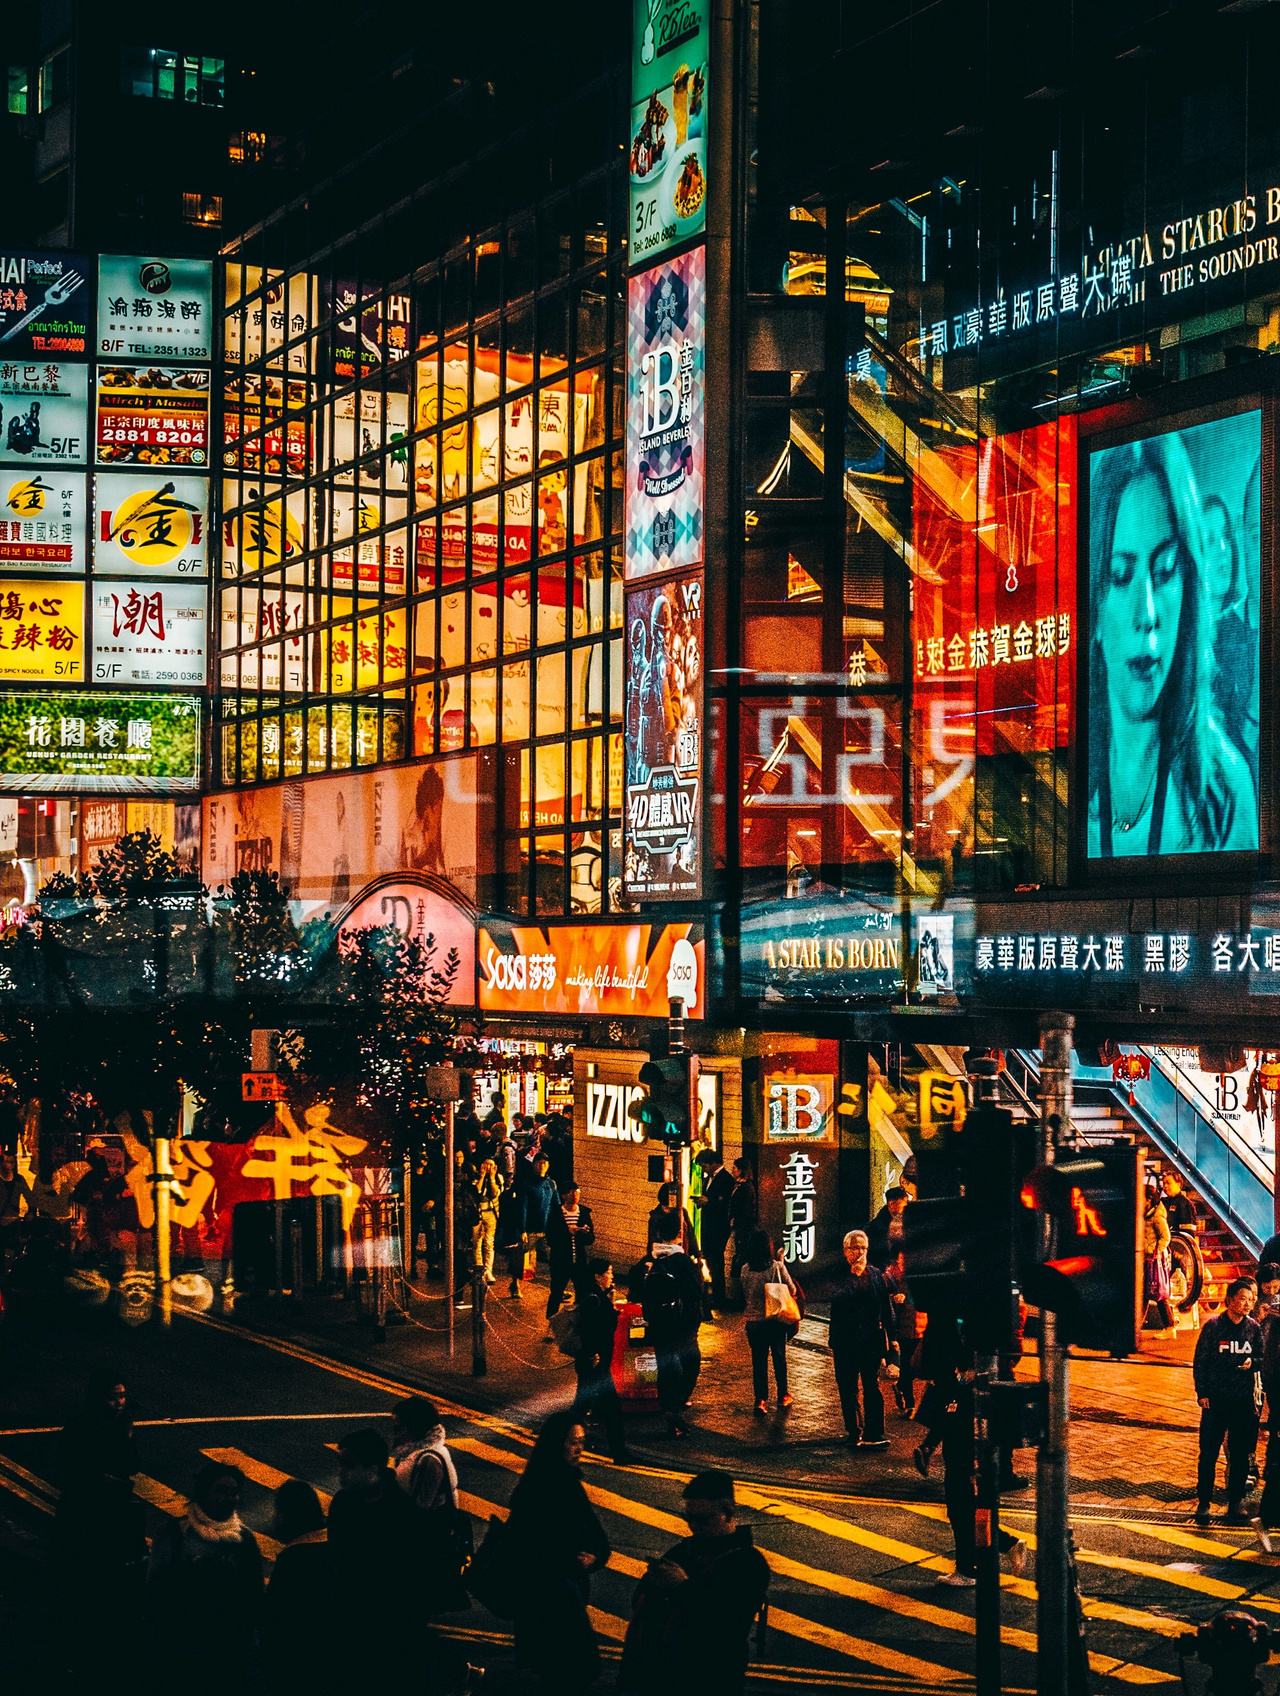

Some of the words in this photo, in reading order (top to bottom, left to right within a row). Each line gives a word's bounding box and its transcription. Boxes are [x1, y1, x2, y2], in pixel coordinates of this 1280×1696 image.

[635, 199, 656, 233] 3/F
[645, 231, 660, 250] 2660
[1161, 207, 1223, 260] STAR
[27, 259, 62, 275] Perfect
[1159, 264, 1194, 296] THE
[966, 254, 1132, 345] 豪華版原聲大碟
[101, 339, 125, 352] 8/F
[128, 344, 152, 354] TEL:
[154, 345, 179, 355] 2351
[182, 347, 208, 357] 1323
[0, 363, 61, 383] 新巴黎
[190, 373, 208, 385] 7/F
[680, 338, 693, 424] 金百利
[103, 396, 144, 406] Mirch
[155, 399, 204, 408] Masala
[103, 416, 206, 431] 正宗印度風味屋
[50, 438, 80, 453] 5/F
[102, 429, 149, 442] 2881
[155, 431, 205, 444] 8204
[638, 437, 661, 454] ISLAND
[662, 425, 693, 446] BEVERLEY
[645, 476, 660, 496] Well
[660, 467, 686, 494] Dressed
[61, 490, 73, 499] 6/F
[177, 559, 202, 573] 6/F
[681, 583, 701, 610] VR
[111, 587, 166, 641] 潮
[54, 661, 80, 675] 5/F
[96, 663, 122, 679] 5/F
[156, 670, 178, 680] 2590
[181, 671, 203, 681] 0368
[172, 705, 193, 717] 4/F
[23, 716, 153, 749] 花園餐廳
[778, 937, 822, 969] STAR
[825, 937, 845, 968] IS
[848, 936, 900, 968] BORN
[976, 935, 1125, 972] 豪華版原聲大碟
[1144, 934, 1191, 972] 黑膠
[528, 953, 557, 991] 莎莎
[565, 966, 594, 999] making
[594, 964, 611, 999] life
[611, 965, 649, 1000] beautiful
[779, 1151, 820, 1264] 金百利
[1218, 1340, 1253, 1355] FILA
